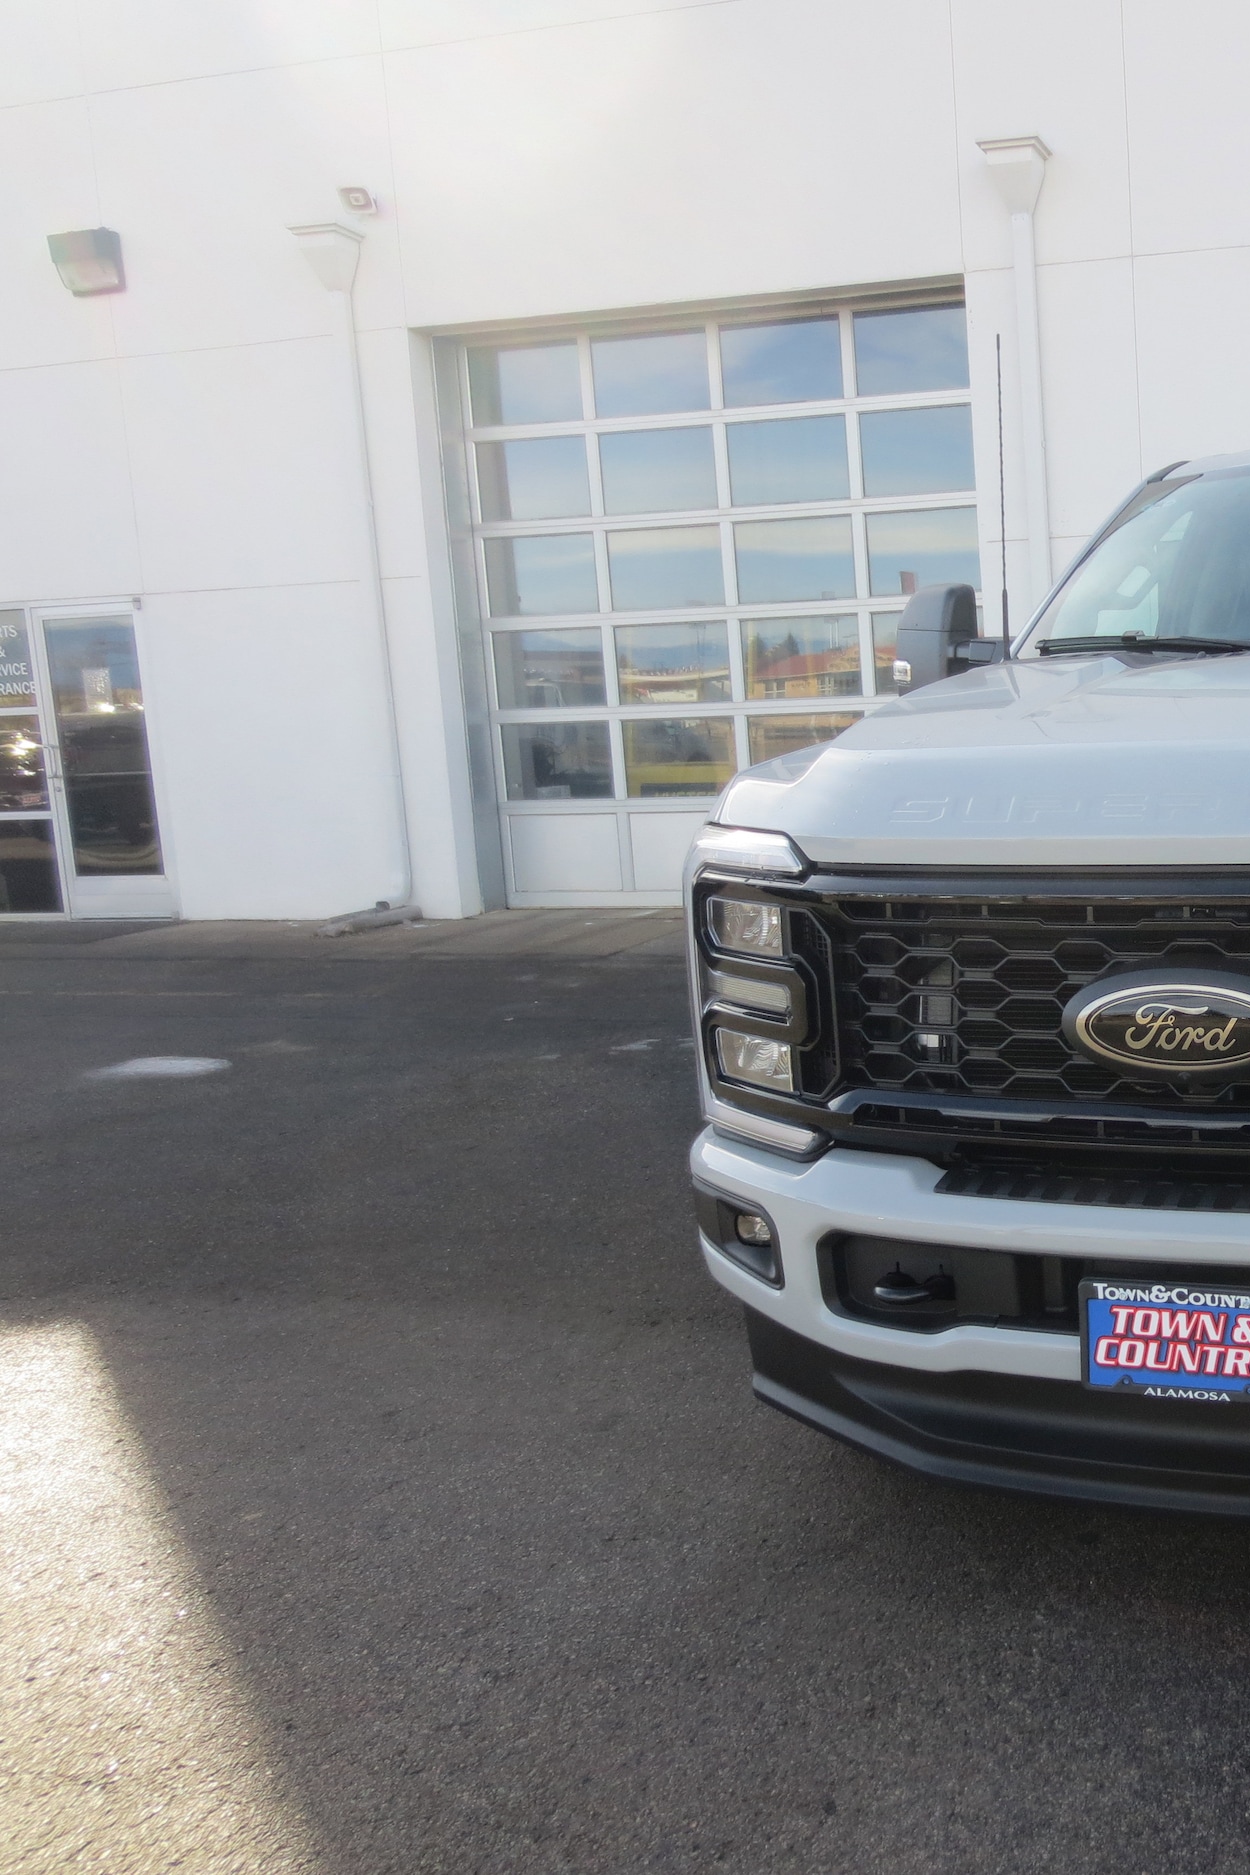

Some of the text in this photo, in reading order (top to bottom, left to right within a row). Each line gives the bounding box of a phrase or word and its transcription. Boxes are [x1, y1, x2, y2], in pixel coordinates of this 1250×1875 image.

[1125, 1003, 1237, 1051] Ford
[1110, 1305, 1228, 1343] TOWN
[1143, 1387, 1231, 1402] ALAMOSA
